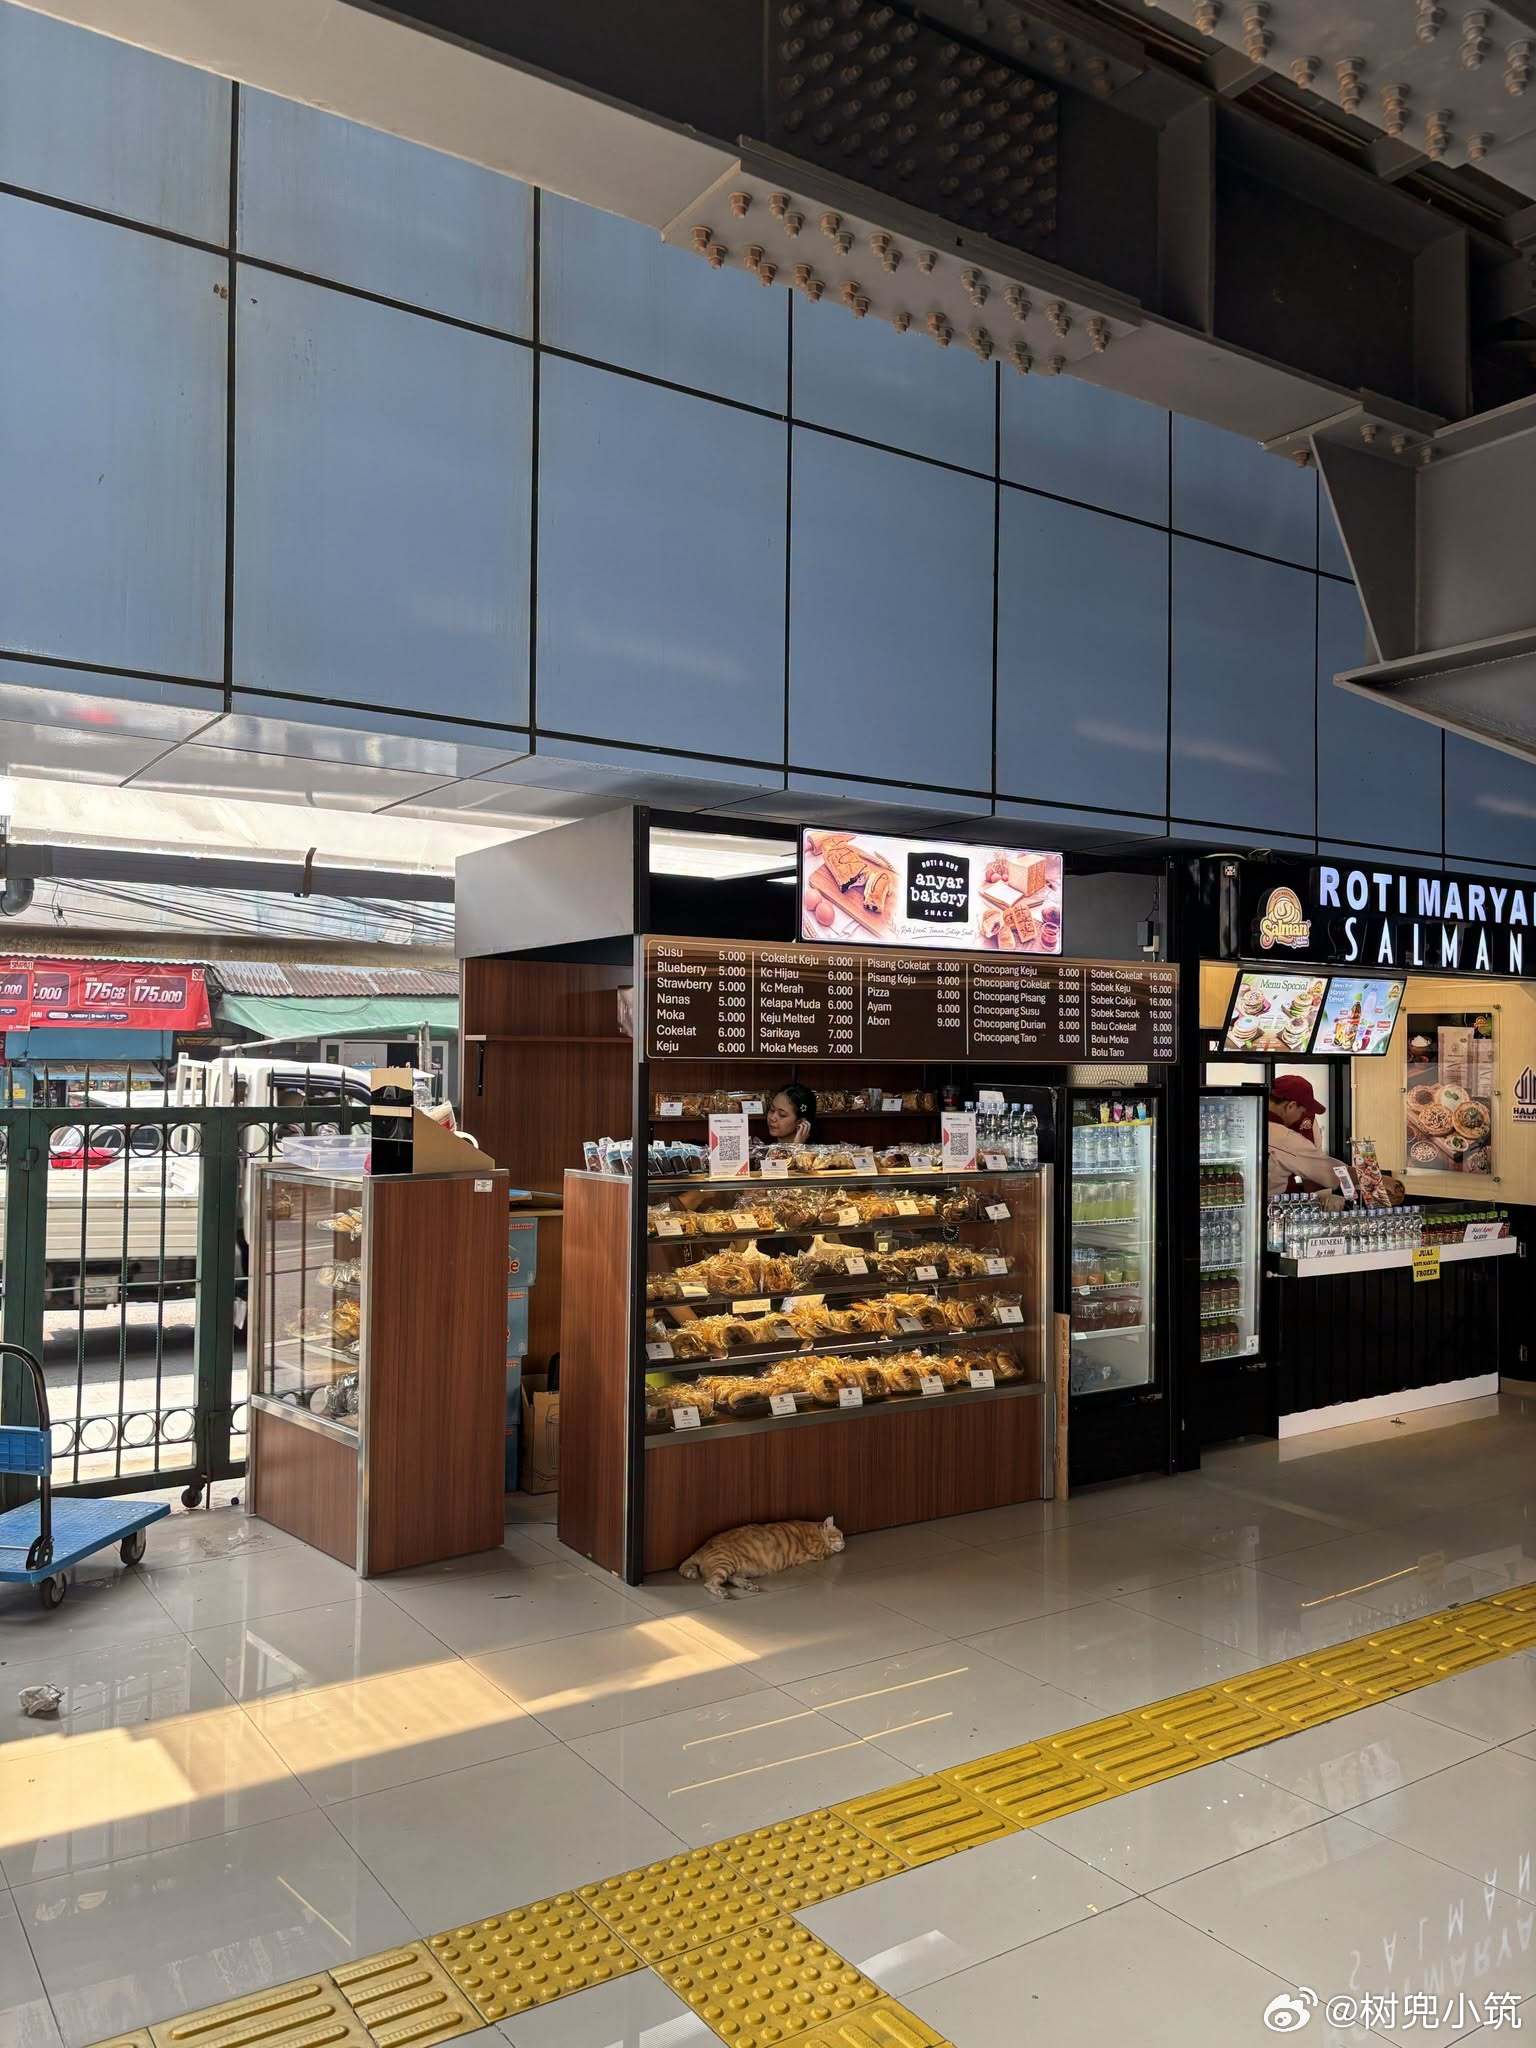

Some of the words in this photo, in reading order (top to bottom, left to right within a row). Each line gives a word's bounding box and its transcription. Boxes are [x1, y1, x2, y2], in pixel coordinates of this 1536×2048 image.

[915, 873, 964, 889] anyar
[910, 886, 967, 907] bakery
[1319, 866, 1407, 914] ROTI
[1418, 878, 1536, 927] MARYA
[924, 909, 953, 917] SNACK
[1262, 919, 1308, 948] Salman
[657, 945, 683, 957] Susu
[718, 951, 746, 961] 5.000
[1345, 917, 1522, 976] SALMAN
[760, 952, 797, 964] Cokelat
[799, 954, 819, 967] Keju
[828, 956, 853, 967] 6.000
[867, 958, 896, 971] Pisang
[897, 959, 930, 971] Cokelat
[937, 962, 960, 972] 8.000
[657, 962, 707, 976] Blueberry
[718, 966, 746, 977] 5.000
[760, 967, 773, 977] Kc
[774, 968, 799, 980] Hijau
[828, 971, 853, 981] 6.000
[973, 963, 1020, 977] Chocopang
[1020, 965, 1038, 977] Keju
[1058, 968, 1080, 977] 8.000
[1091, 969, 1114, 979] Sobek
[1115, 970, 1143, 980] Cokelat
[1149, 972, 1172, 981] 16.000
[657, 977, 712, 992] Strawberry
[718, 981, 746, 992] 5.000
[867, 972, 896, 986] Pisang
[897, 974, 916, 986] Keju
[937, 976, 960, 986] 8.000
[973, 977, 1020, 990] Chocopang
[1020, 979, 1050, 990] Cokelat
[1058, 981, 1080, 990] 8.000
[1260, 979, 1281, 989] Menu
[1281, 980, 1309, 991] Special
[133, 985, 183, 1003] 175.000
[760, 982, 773, 993] Kc
[774, 983, 804, 993] Merah
[828, 985, 853, 996] 6.000
[867, 987, 890, 997] Pizza
[937, 990, 960, 1000] 8.000
[1091, 982, 1114, 992] Sobek
[1115, 984, 1131, 994] Keju
[1149, 985, 1172, 994] 16.000
[657, 993, 691, 1004] Nanas
[718, 996, 746, 1007] 5.000
[760, 997, 793, 1010] Kelapa
[794, 998, 821, 1009] Muda
[828, 1000, 853, 1010] 6.000
[973, 991, 1020, 1004] Chocopang
[1020, 993, 1046, 1005] Pisang
[1058, 995, 1080, 1004] 8.000
[1091, 995, 1114, 1005] Sobek
[1115, 996, 1136, 1007] Cokju
[1149, 998, 1172, 1006] 16.000
[867, 1001, 892, 1013] Ayam
[937, 1004, 960, 1014] 8.000
[973, 1004, 1020, 1017] Chocopang
[1020, 1006, 1040, 1016] Susu
[1058, 1008, 1080, 1017] 8.000
[1091, 1009, 1114, 1018] Sobek
[1115, 1009, 1140, 1019] Sarcok
[1149, 1011, 1172, 1019] 16.000
[657, 1009, 685, 1020] Moka
[718, 1012, 746, 1022] 5.000
[760, 1012, 781, 1025] Keju
[783, 1013, 815, 1024] Melted
[828, 1015, 853, 1025] 7.000
[867, 1016, 890, 1026] Abon
[937, 1018, 960, 1027] 9.000
[656, 1025, 696, 1036] Cokelat
[718, 1027, 746, 1037] 6.000
[973, 1018, 1020, 1031] Chocopang
[1020, 1020, 1046, 1030] Durian
[1058, 1021, 1080, 1030] 8.000
[1091, 1022, 1108, 1031] Bolu
[1109, 1022, 1137, 1031] Cokelat
[760, 1027, 800, 1040] Sarikaya
[828, 1029, 853, 1039] 7.000
[973, 1032, 1020, 1044] Chocopang
[1020, 1033, 1037, 1043] Taro
[1058, 1034, 1080, 1043] 8.000
[1091, 1035, 1108, 1044] Bolu
[1109, 1035, 1129, 1044] Moka
[1153, 1036, 1172, 1044] 8.000
[656, 1040, 679, 1053] Keju
[718, 1043, 746, 1053] 6.000
[760, 1042, 786, 1053] Moka
[788, 1043, 818, 1053] Meses
[828, 1044, 853, 1054] 7.000
[1091, 1047, 1108, 1057] Bolu
[1109, 1048, 1125, 1057] Taro
[1153, 1049, 1172, 1057] 8.000
[1416, 1269, 1437, 1277] FROZEN
